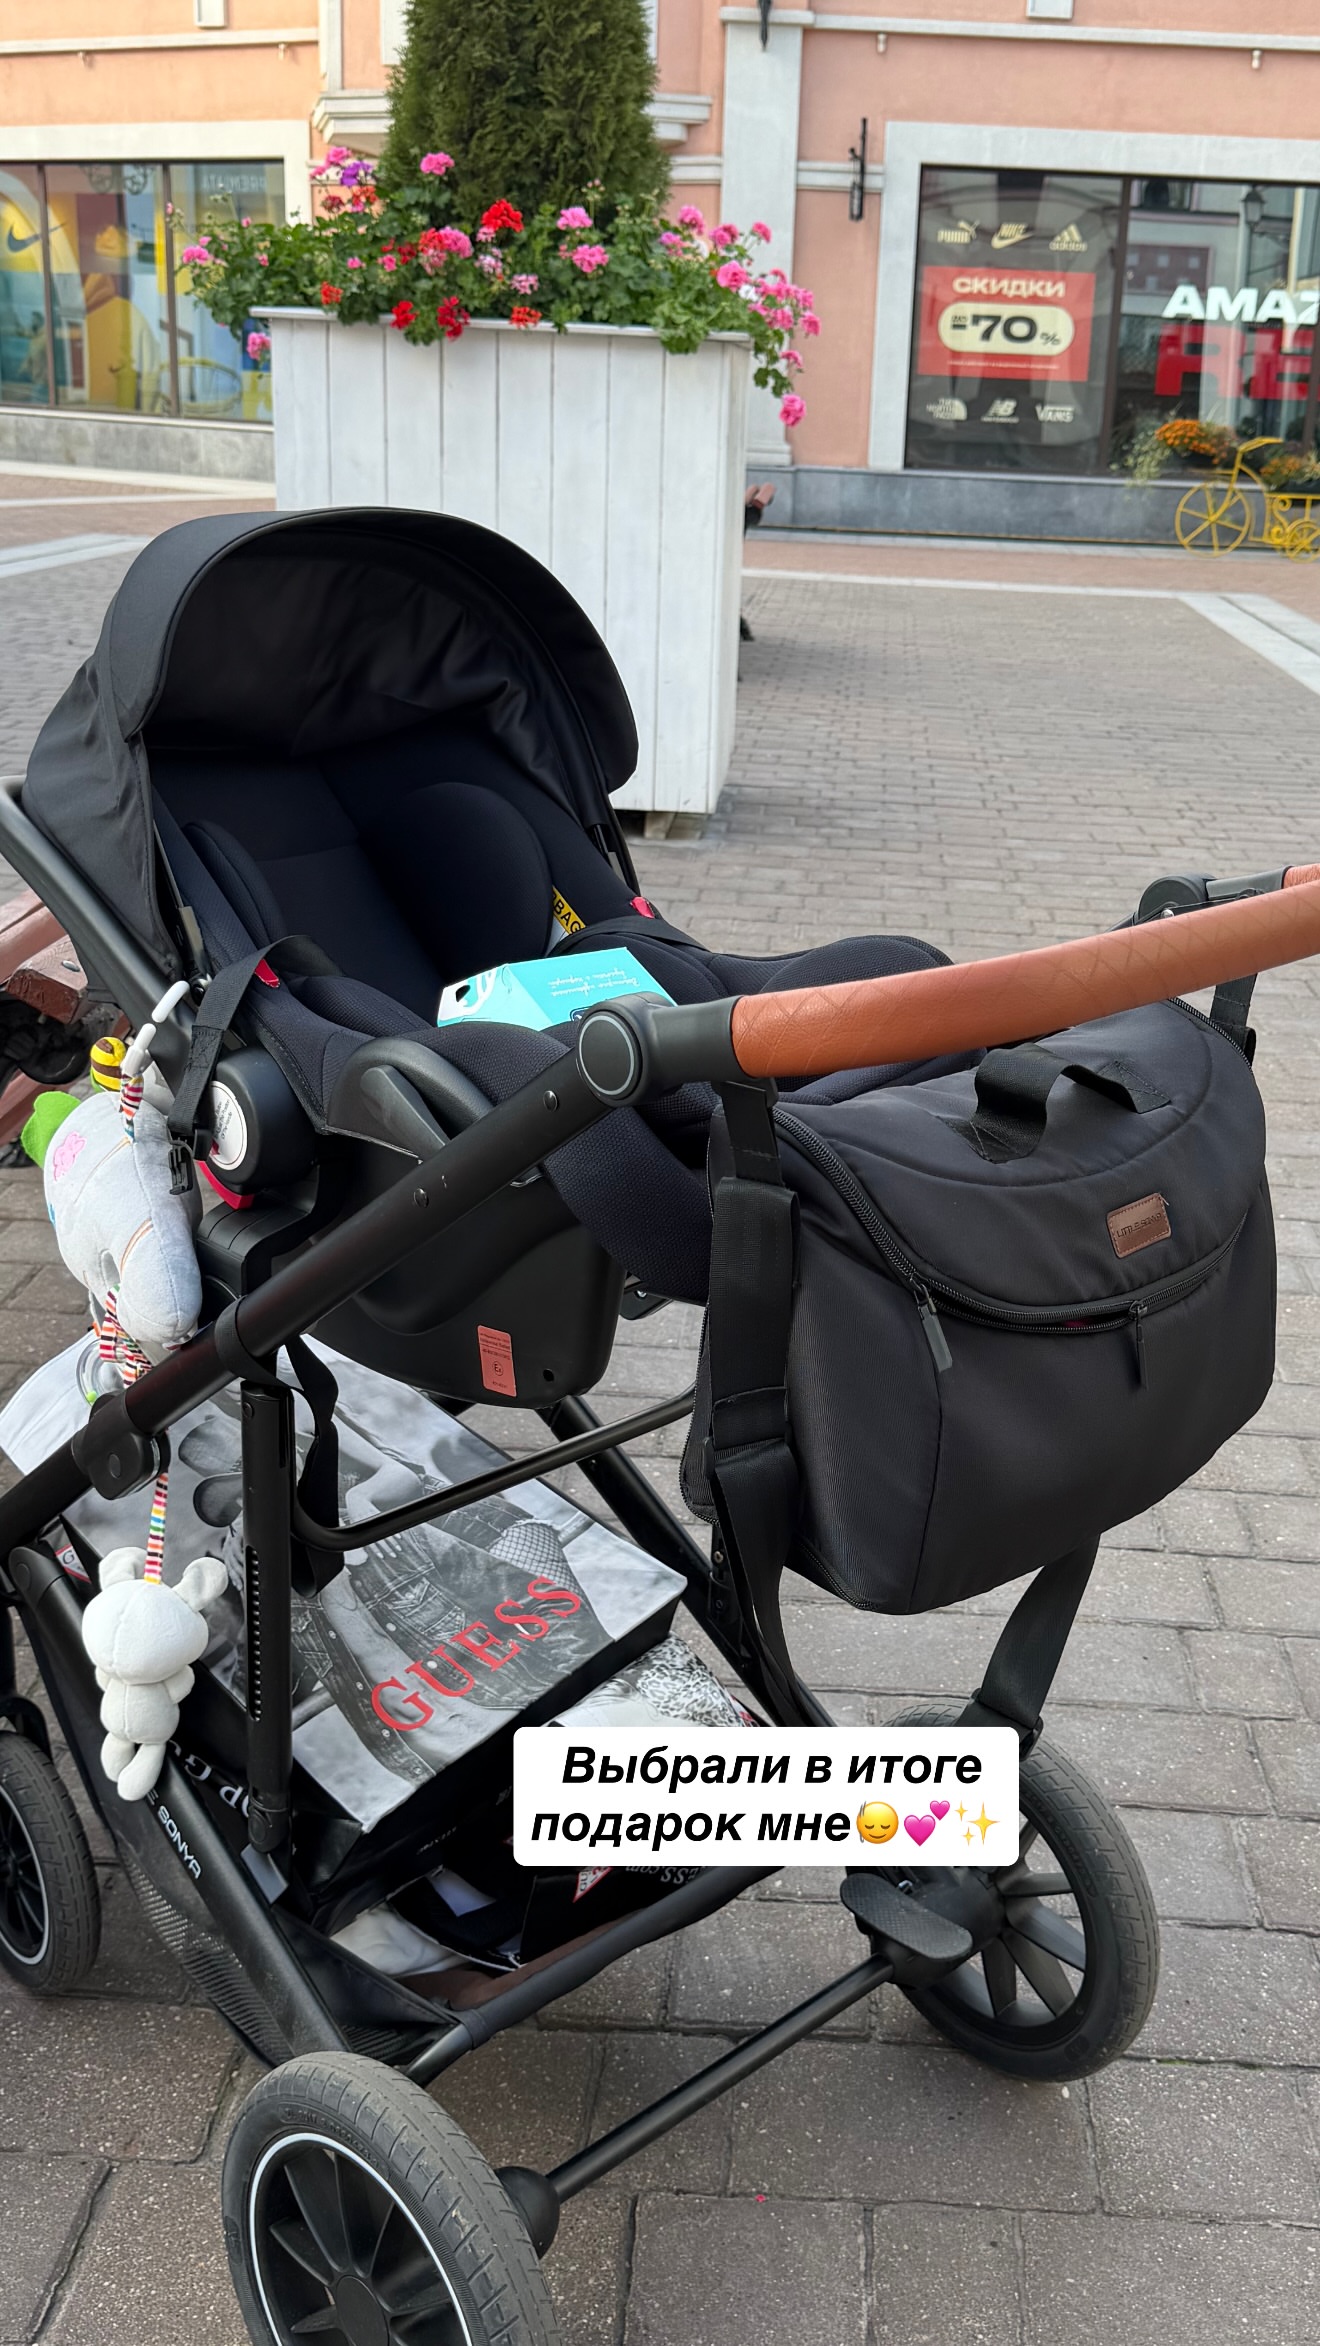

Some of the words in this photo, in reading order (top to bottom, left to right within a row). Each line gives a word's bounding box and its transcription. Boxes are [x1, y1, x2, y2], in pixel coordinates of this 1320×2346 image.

[953, 276, 1066, 298] СКИДКИ
[371, 1576, 581, 1731] GUESS
[157, 1805, 201, 1879] SONYA
